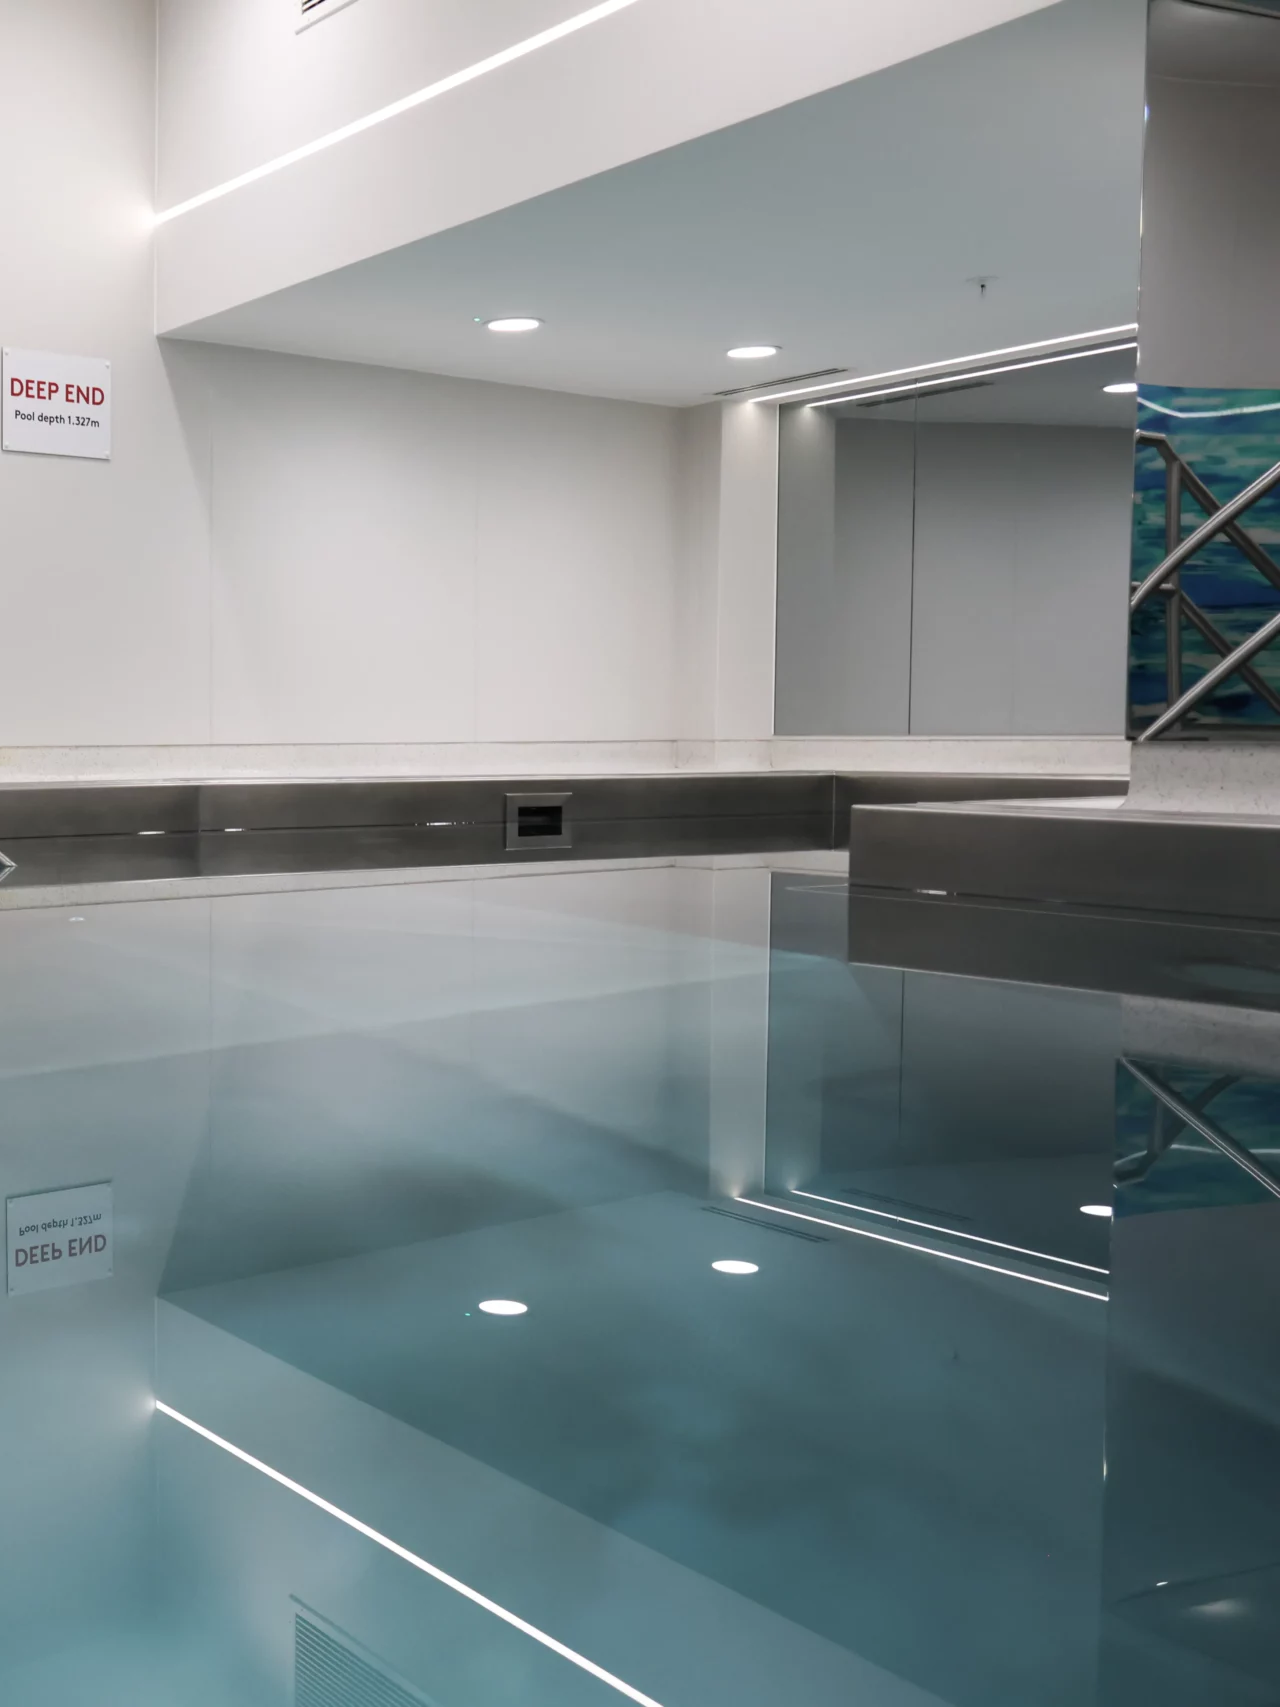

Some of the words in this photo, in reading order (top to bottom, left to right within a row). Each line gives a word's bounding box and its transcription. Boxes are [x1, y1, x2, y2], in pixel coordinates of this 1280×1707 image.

[10, 377, 59, 400] DEEP
[65, 384, 105, 406] END
[15, 410, 35, 421] Pool
[37, 413, 65, 425] depth
[68, 416, 100, 428] 1.327m
